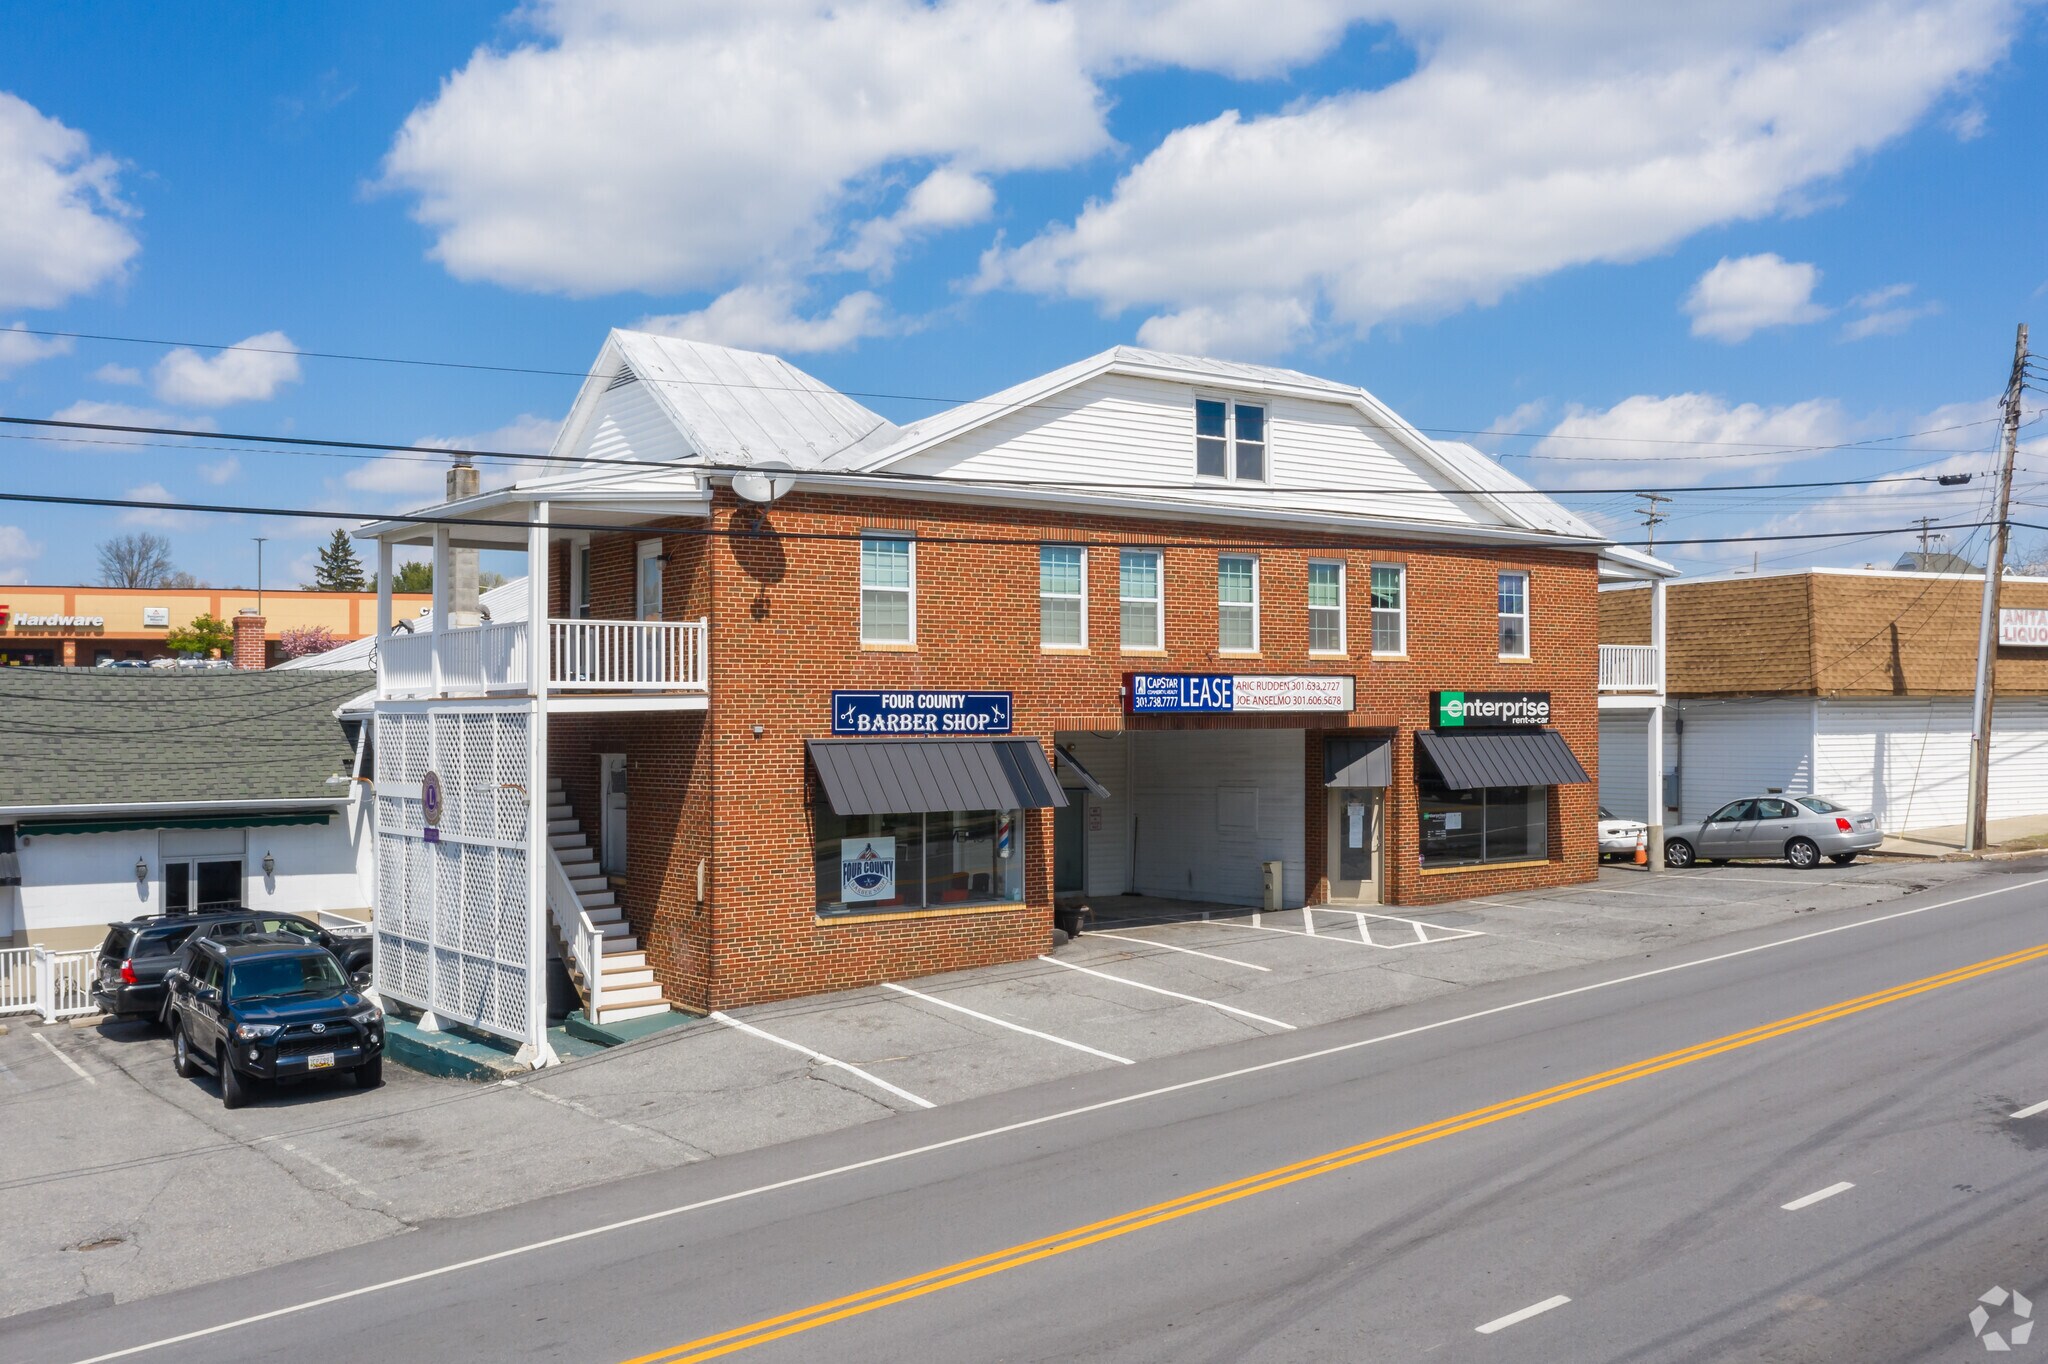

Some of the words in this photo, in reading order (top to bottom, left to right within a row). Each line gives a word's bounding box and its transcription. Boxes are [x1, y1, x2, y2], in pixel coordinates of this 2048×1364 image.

[13, 612, 104, 627] Hardware
[1180, 677, 1231, 707] LEASE
[1236, 681, 1255, 691] ARIC
[1256, 681, 1290, 691] RUDDEN
[881, 694, 914, 709] FOUR
[917, 694, 966, 709] COUNTY
[1135, 696, 1179, 708] 301.738.7777
[1236, 695, 1251, 705] JOE
[1252, 695, 1292, 705] ANSELMO
[1293, 695, 1342, 705] 301.606.5678
[1442, 697, 1549, 721] enterprise
[857, 713, 938, 732] BARBER
[942, 713, 990, 731] SHOP
[1512, 716, 1549, 724] rent-a-car
[843, 862, 862, 886] FOUR
[864, 861, 894, 881] COUNTY
